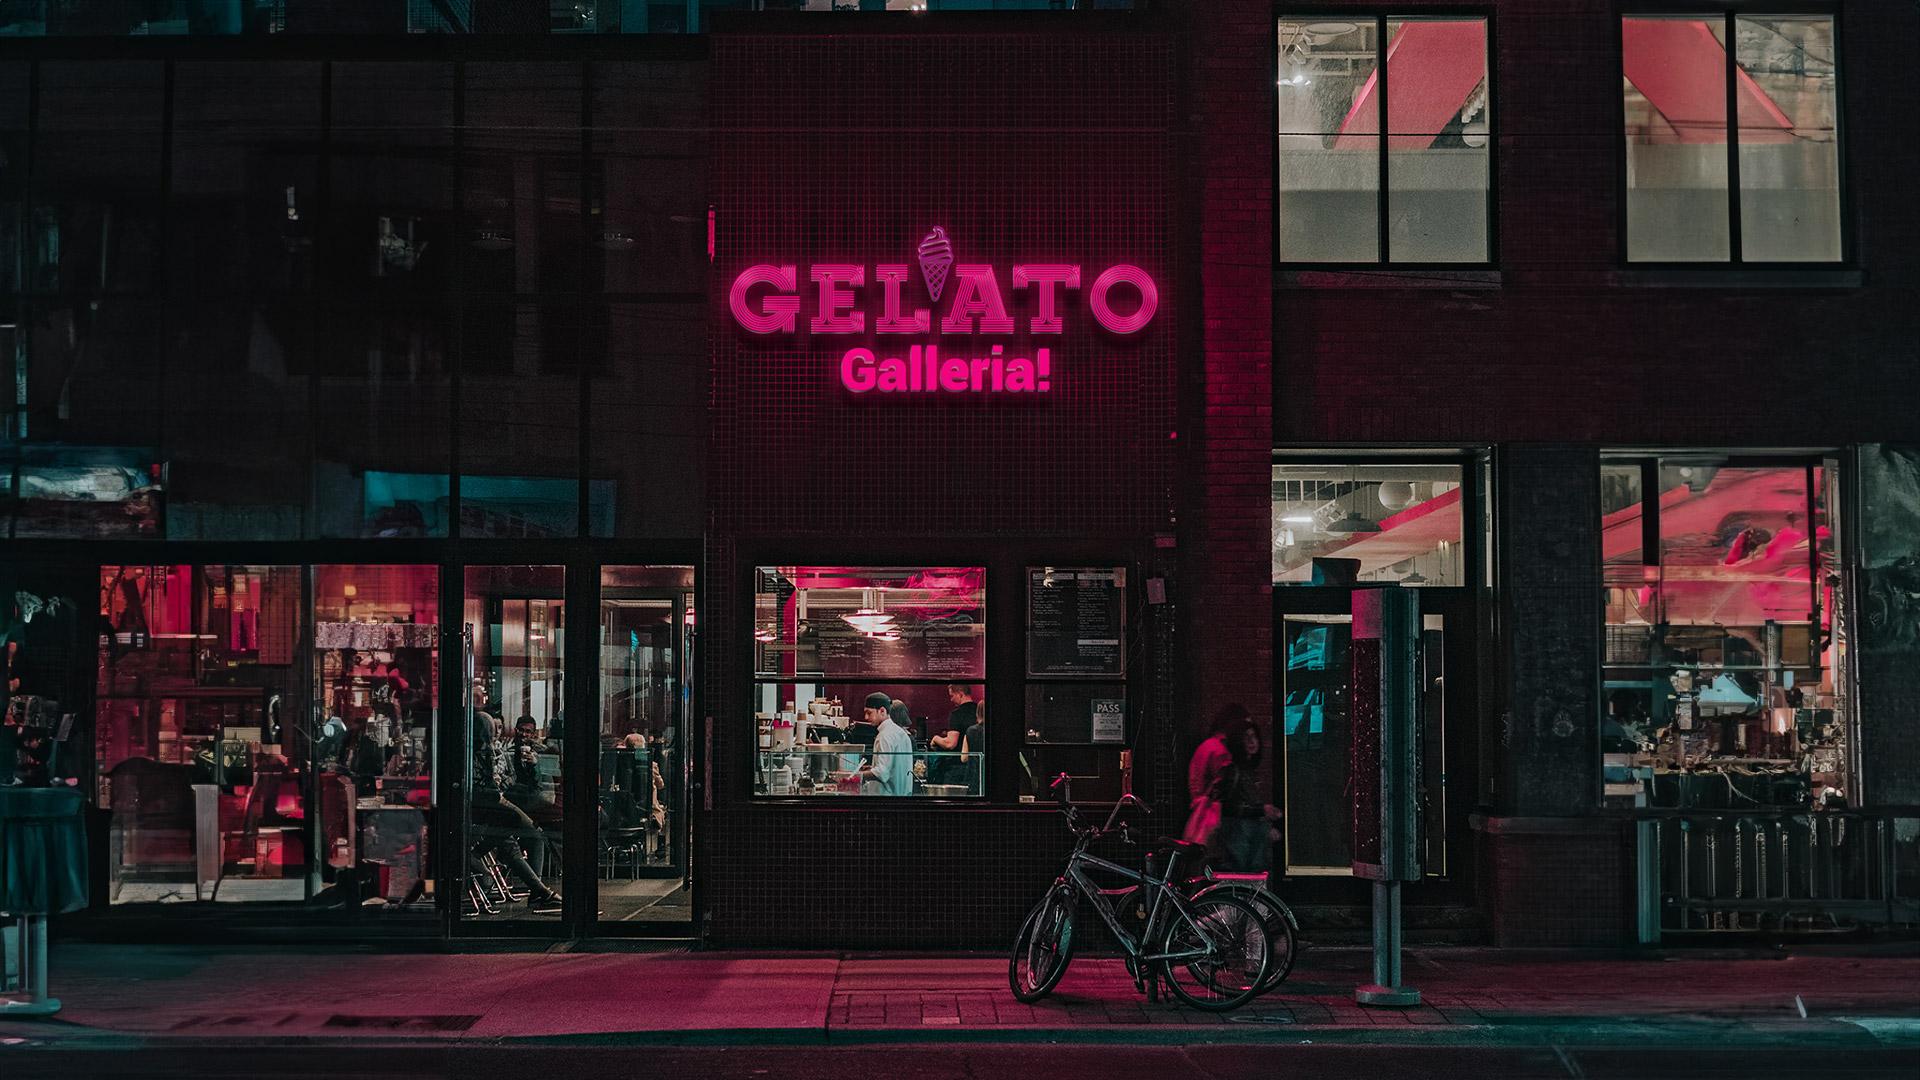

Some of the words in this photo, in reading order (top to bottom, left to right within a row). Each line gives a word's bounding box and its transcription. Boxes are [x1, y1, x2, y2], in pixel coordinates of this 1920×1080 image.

[729, 265, 1158, 334] GELATO
[841, 345, 1050, 392] Galleria!
[1097, 704, 1120, 713] PASS
